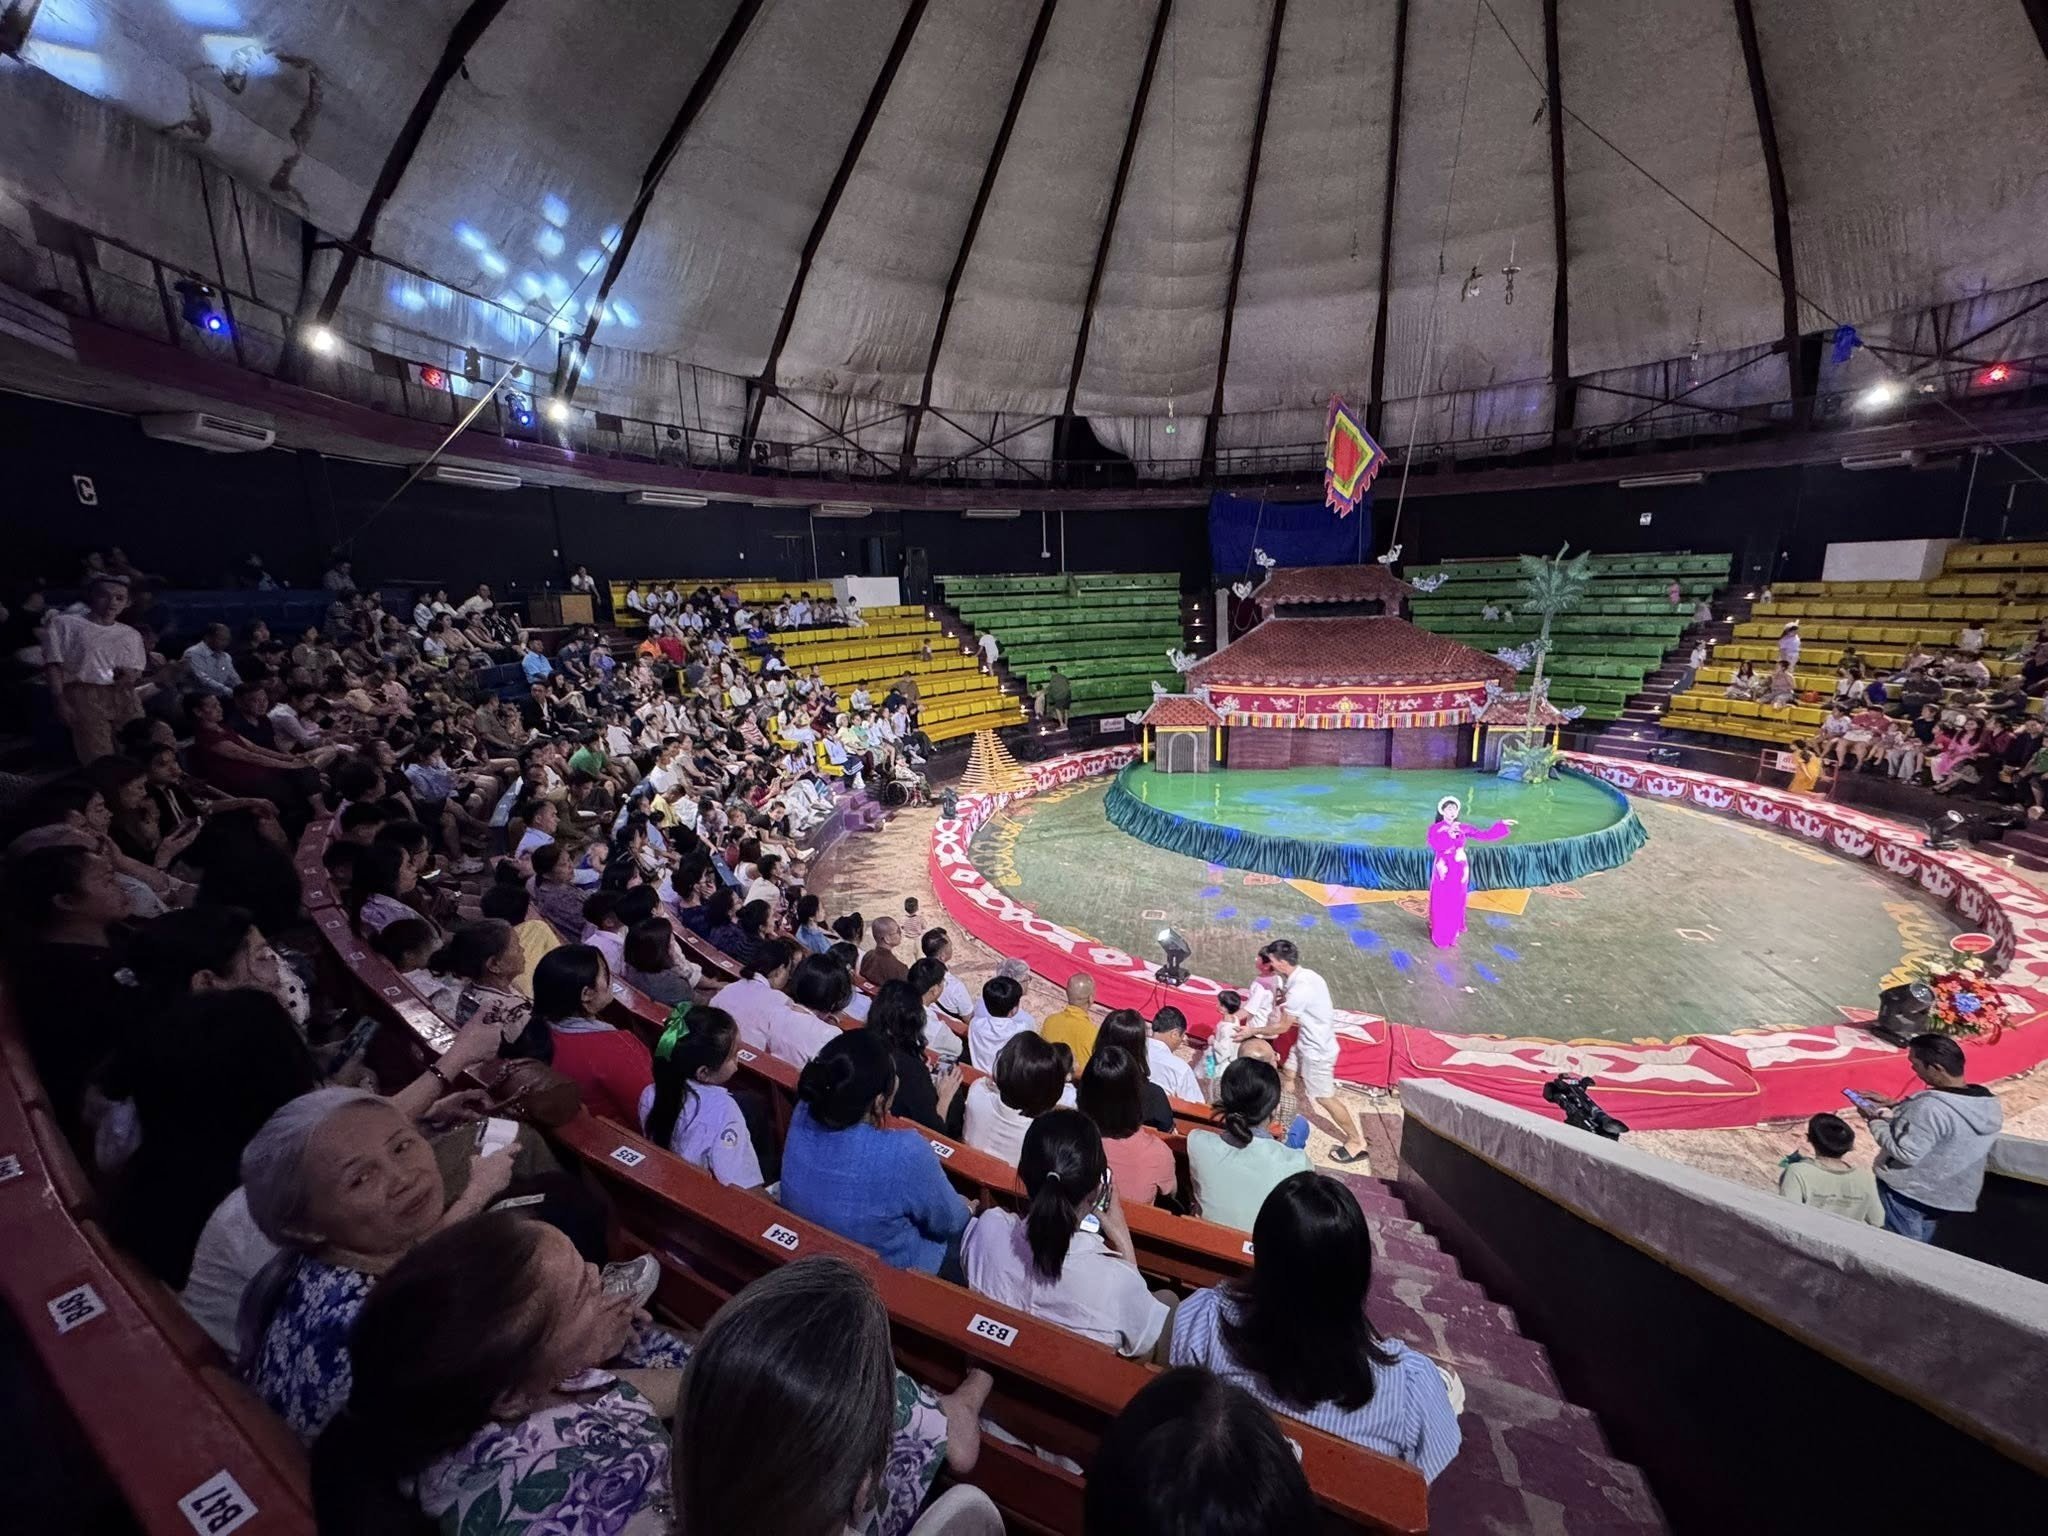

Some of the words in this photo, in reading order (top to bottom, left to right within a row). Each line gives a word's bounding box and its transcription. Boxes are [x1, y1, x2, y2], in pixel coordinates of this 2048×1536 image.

[616, 1149, 639, 1162] B35
[932, 1143, 950, 1155] B22
[770, 1229, 797, 1245] B34
[56, 1292, 95, 1325] B48
[976, 1320, 1009, 1341] B33
[190, 1486, 244, 1534] B47
